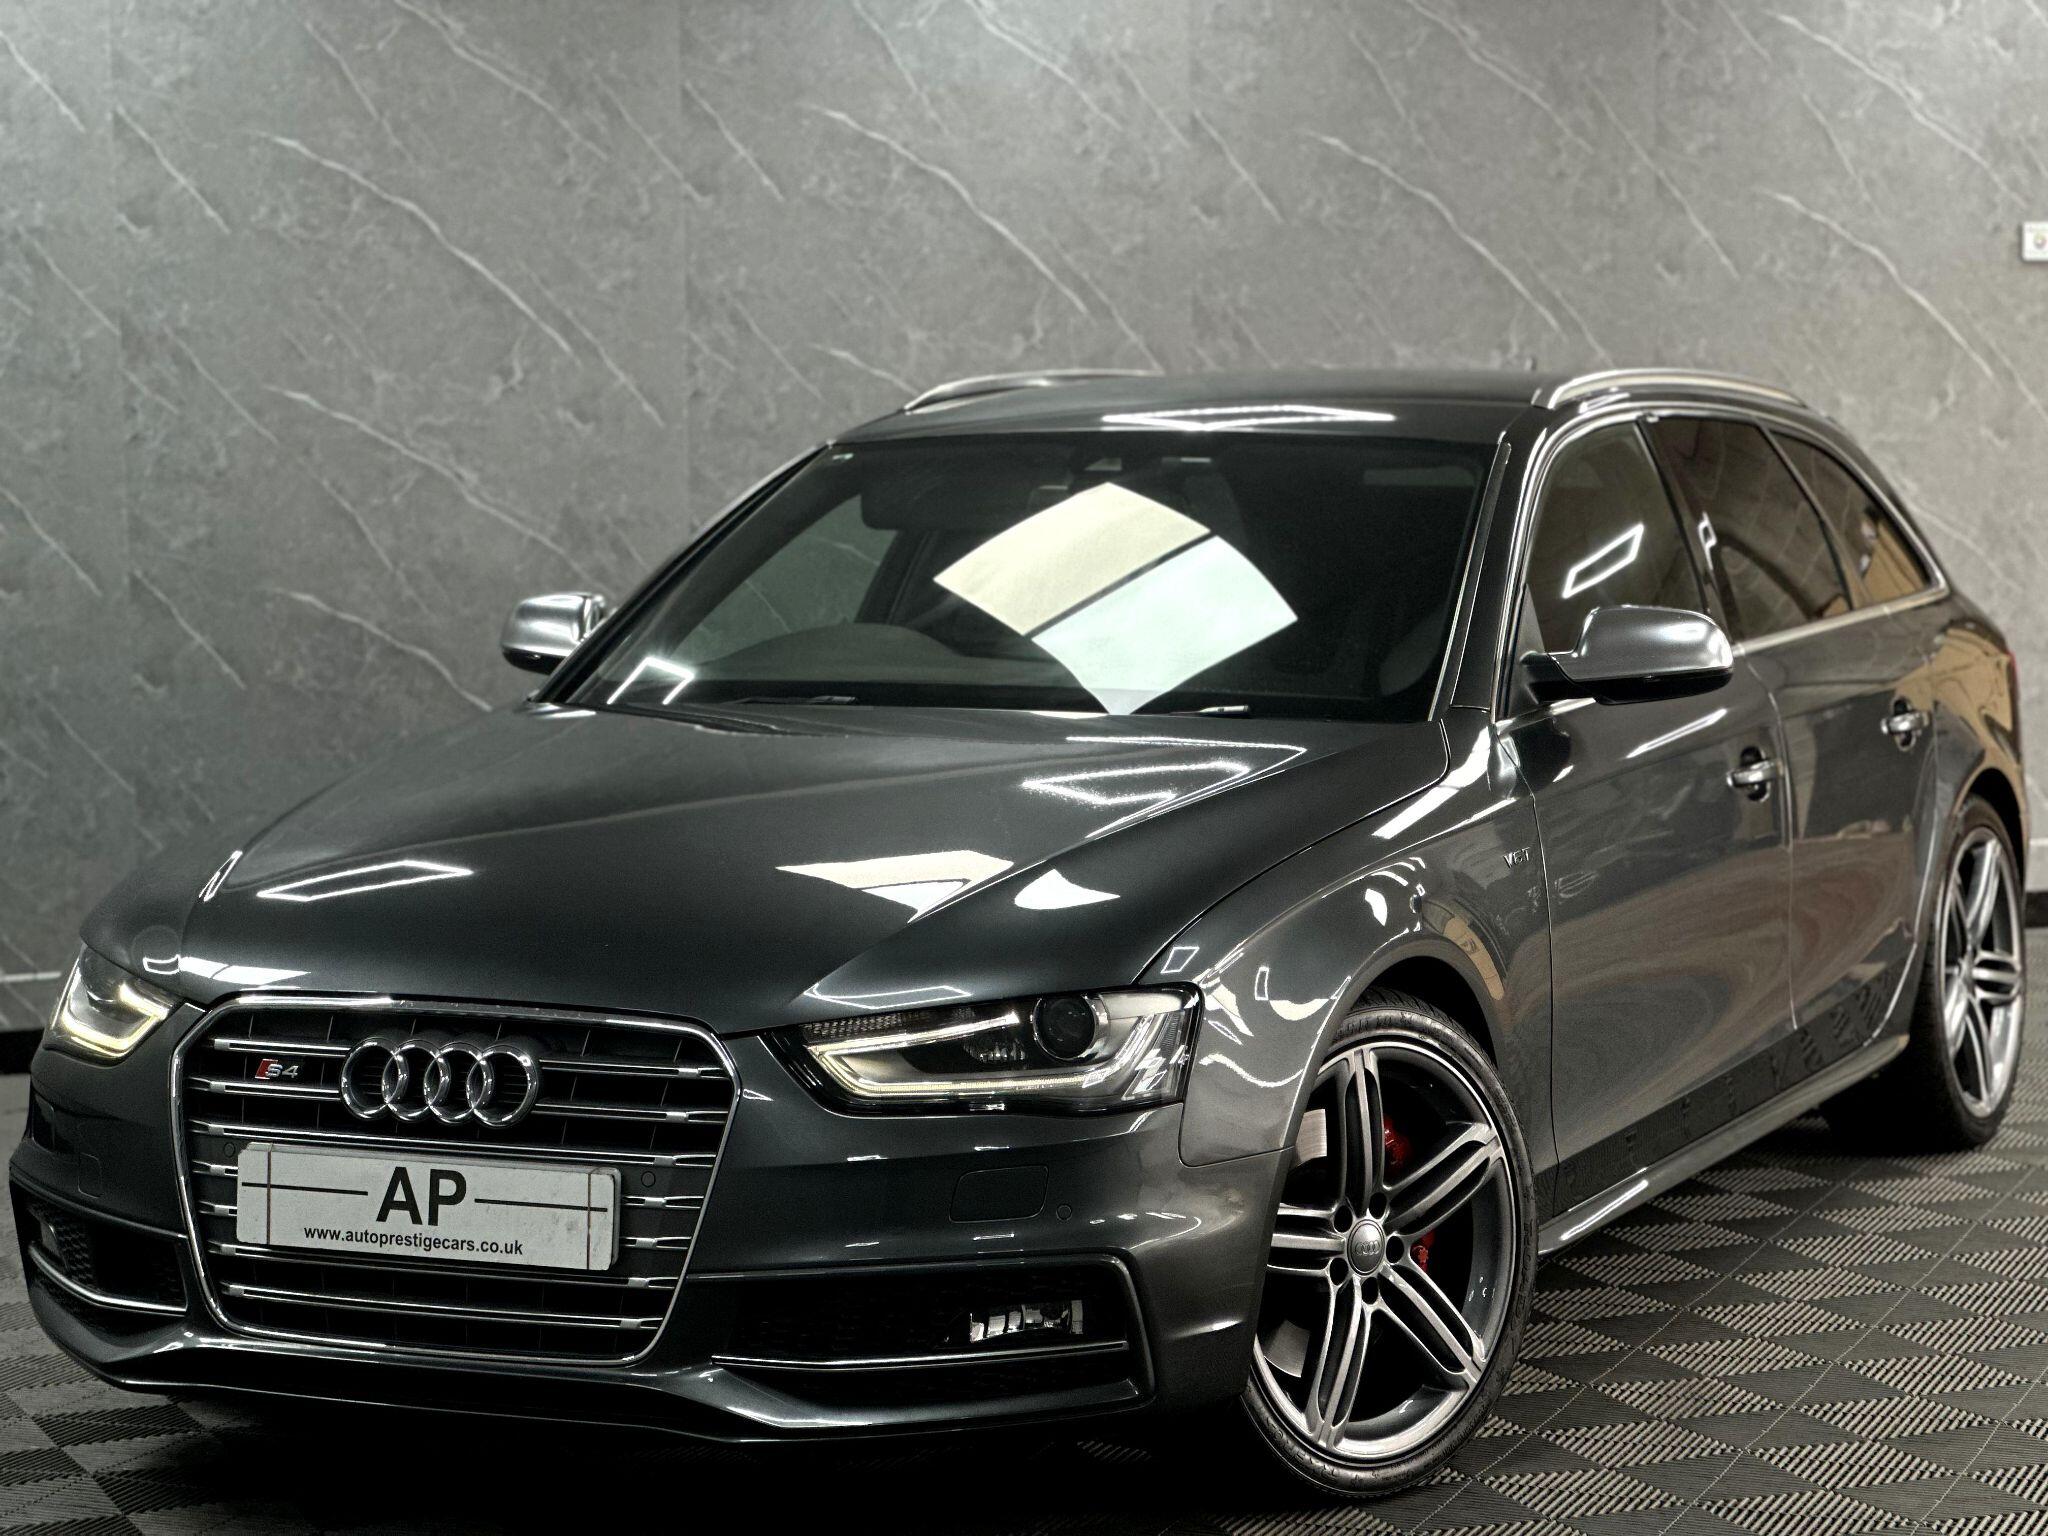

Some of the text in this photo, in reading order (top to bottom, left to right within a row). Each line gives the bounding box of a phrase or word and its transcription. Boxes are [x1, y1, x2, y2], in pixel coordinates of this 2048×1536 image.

[263, 1062, 299, 1079] S4
[376, 1166, 467, 1226] AP
[303, 1227, 523, 1255] www.autoprestigecars.co.uk
